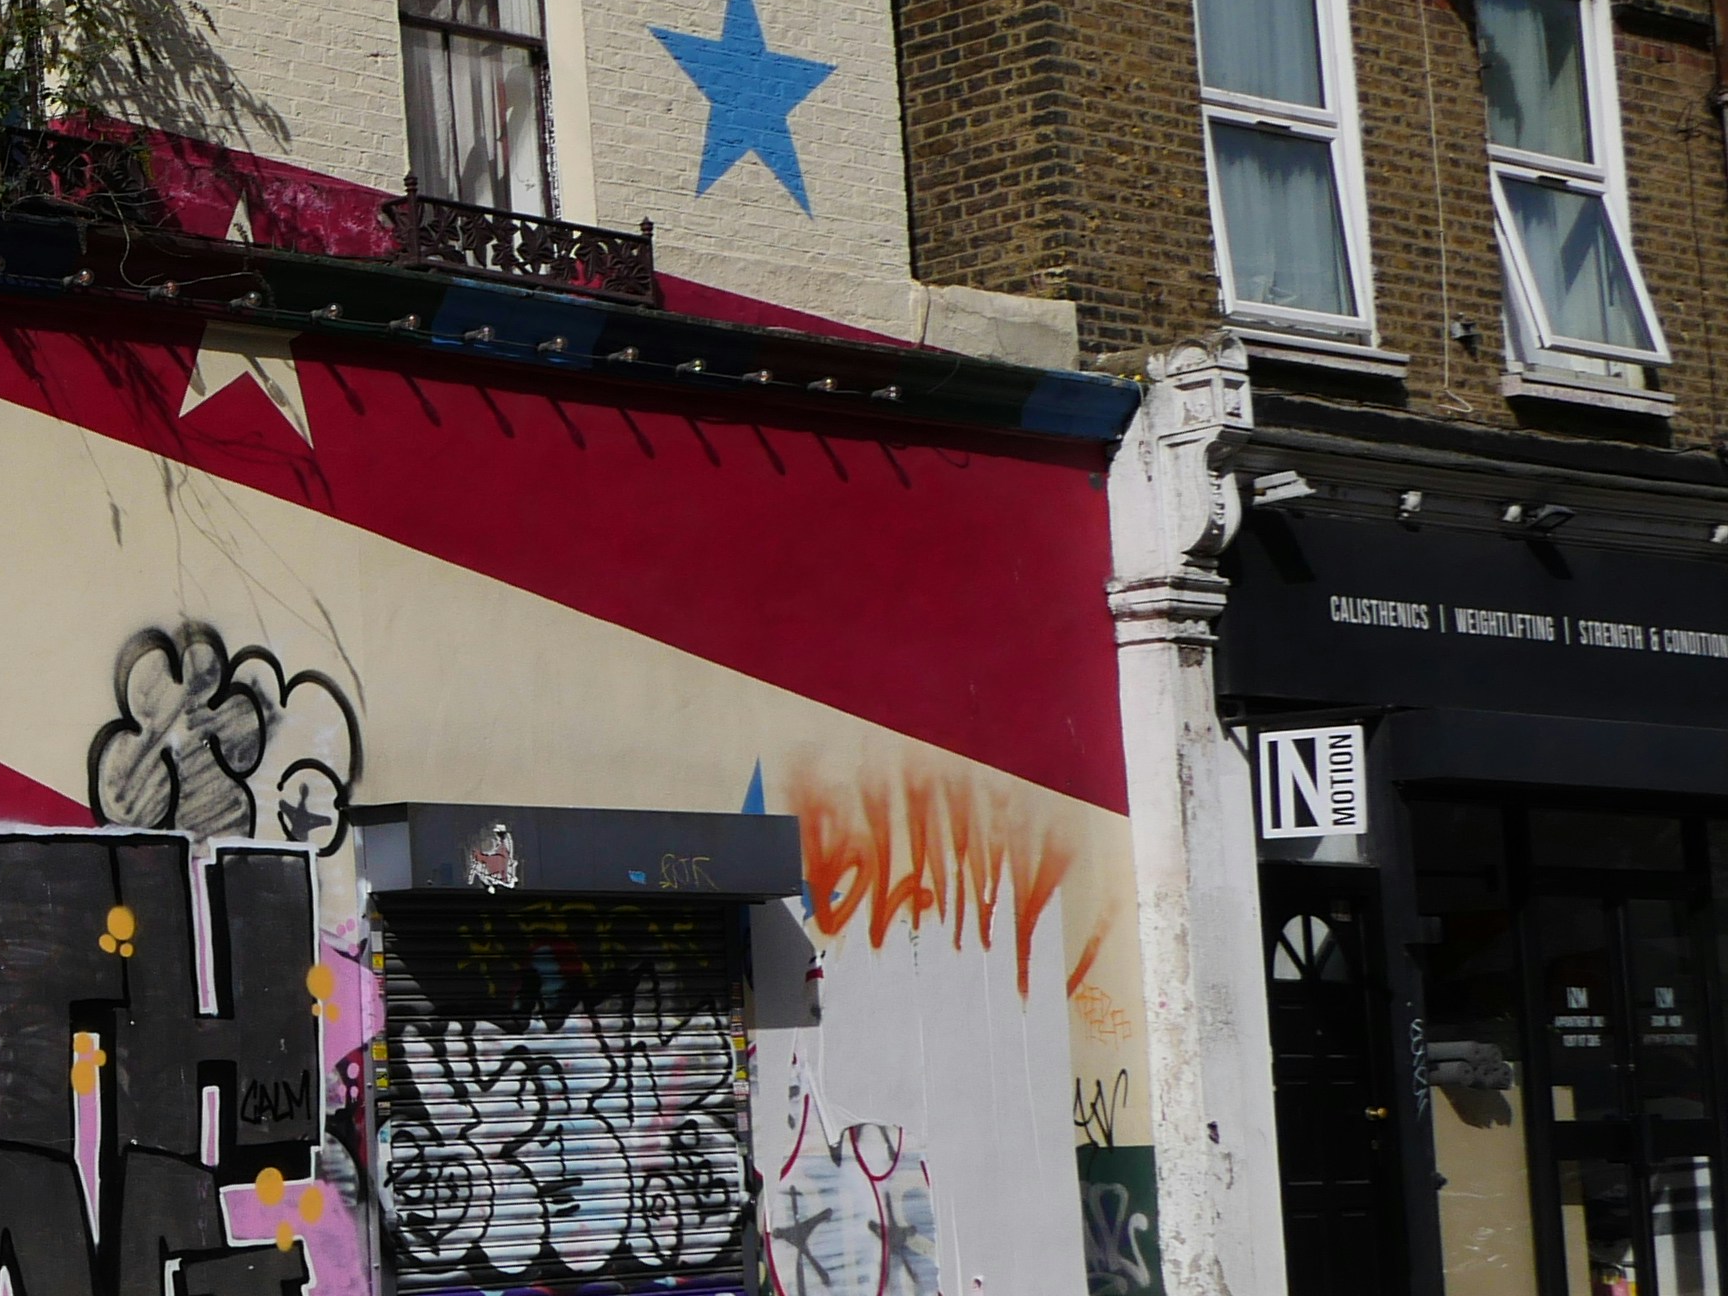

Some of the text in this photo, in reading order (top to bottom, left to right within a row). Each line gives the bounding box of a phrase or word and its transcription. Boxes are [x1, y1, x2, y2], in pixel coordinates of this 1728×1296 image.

[1330, 595, 1430, 630] CALISTHENICS
[1455, 607, 1555, 642] WEIGHTLIFTING
[1578, 620, 1644, 650] STRENGTH
[1650, 627, 1660, 651] &
[1328, 734, 1356, 826] MOTION
